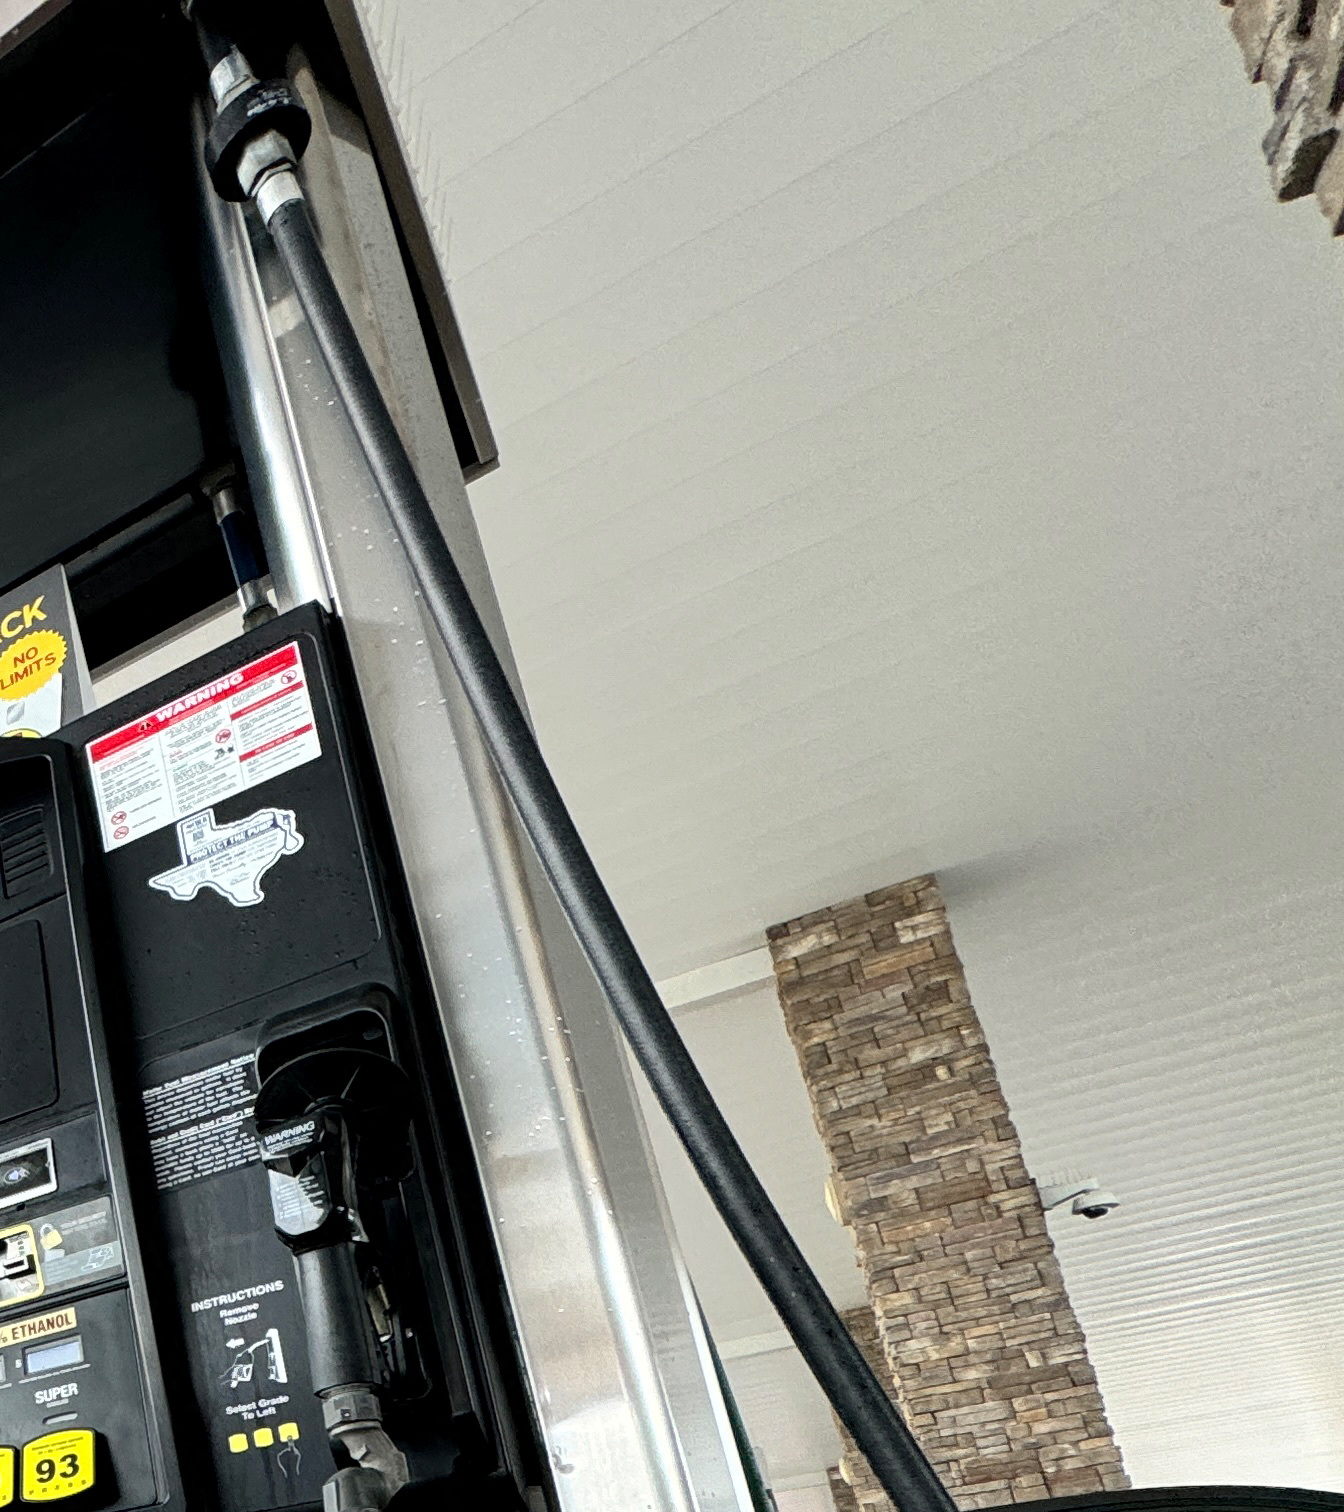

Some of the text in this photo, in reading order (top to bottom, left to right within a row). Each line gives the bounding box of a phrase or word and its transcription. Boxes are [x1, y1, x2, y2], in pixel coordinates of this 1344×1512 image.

[13, 646, 39, 668] NO
[0, 652, 57, 690] LIMITS
[155, 672, 244, 722] WARNING
[265, 1121, 315, 1145] WARNING
[191, 1280, 284, 1312] INSTRUCTIONS
[219, 1303, 259, 1318] Remove
[224, 1311, 257, 1326] Nozzle
[11, 1313, 73, 1340] ETHANOL
[35, 1383, 78, 1403] SUPER
[226, 1395, 289, 1415] Select Grade
[242, 1406, 276, 1421] To Left
[36, 1453, 79, 1483] 93
